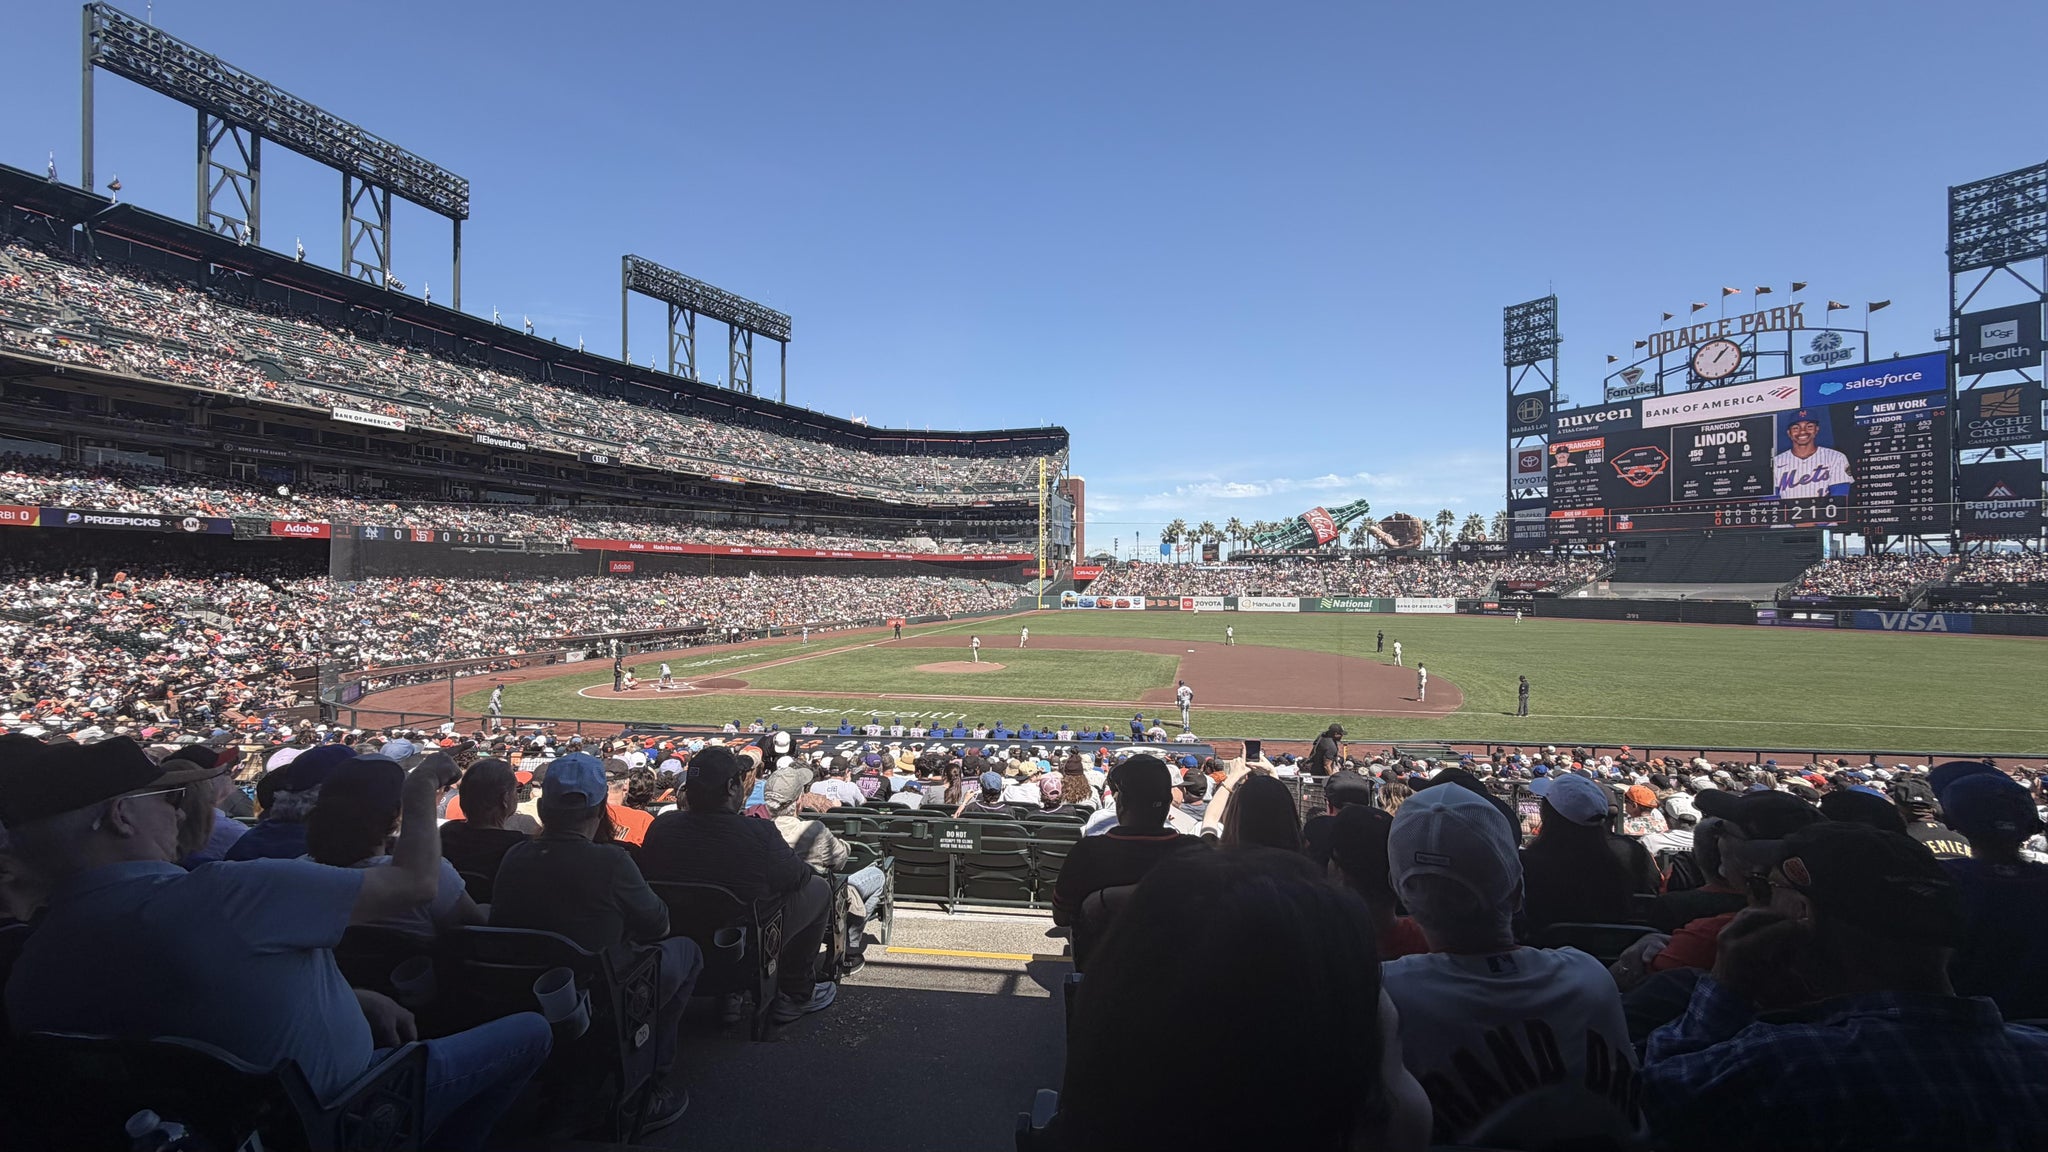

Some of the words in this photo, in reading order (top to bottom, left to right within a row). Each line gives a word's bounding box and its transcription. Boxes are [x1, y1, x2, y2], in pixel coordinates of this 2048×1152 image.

[1649, 318, 1732, 358] ORACLE
[1740, 303, 1804, 334] PARK
[1984, 330, 2014, 338] UCSF
[1804, 348, 1850, 364] coupa
[1969, 346, 2030, 364] Health
[1846, 370, 1922, 390] salesforce
[1606, 383, 1656, 398] Fanatics
[1646, 406, 1678, 418] BANK
[1683, 404, 1699, 412] OF
[1702, 395, 1764, 410] AMERICA
[1873, 404, 1896, 413] NEW
[1897, 399, 1927, 409] YORK
[1558, 408, 1632, 428] nuveen
[1872, 415, 1902, 424] LINDOR
[1968, 416, 2032, 429] CACHE
[1512, 425, 1534, 433] HABBAS
[1701, 422, 1740, 432] FRANCISCO
[1970, 425, 2030, 438] CREEK
[1566, 440, 1601, 449] FRANCISCO
[1694, 430, 1747, 447] LINDOR
[1513, 476, 1548, 484] TOYOTA
[1780, 464, 1830, 492] Mets
[1792, 507, 1802, 519] 2
[1811, 506, 1816, 518] 1
[1826, 504, 1836, 518] 0
[1965, 499, 2036, 511] Benjamin
[20, 511, 29, 520] 0
[84, 515, 161, 527] PRIZEPICKS
[1975, 510, 2025, 519] Moore
[284, 523, 319, 533] Adobe
[394, 530, 402, 539] 0
[443, 532, 450, 542] 0
[463, 534, 469, 543] 2
[488, 534, 494, 543] 0
[1333, 600, 1373, 608] National
[1876, 613, 1948, 632] VISA
[770, 705, 839, 714] UCSF
[840, 708, 967, 720] Health
